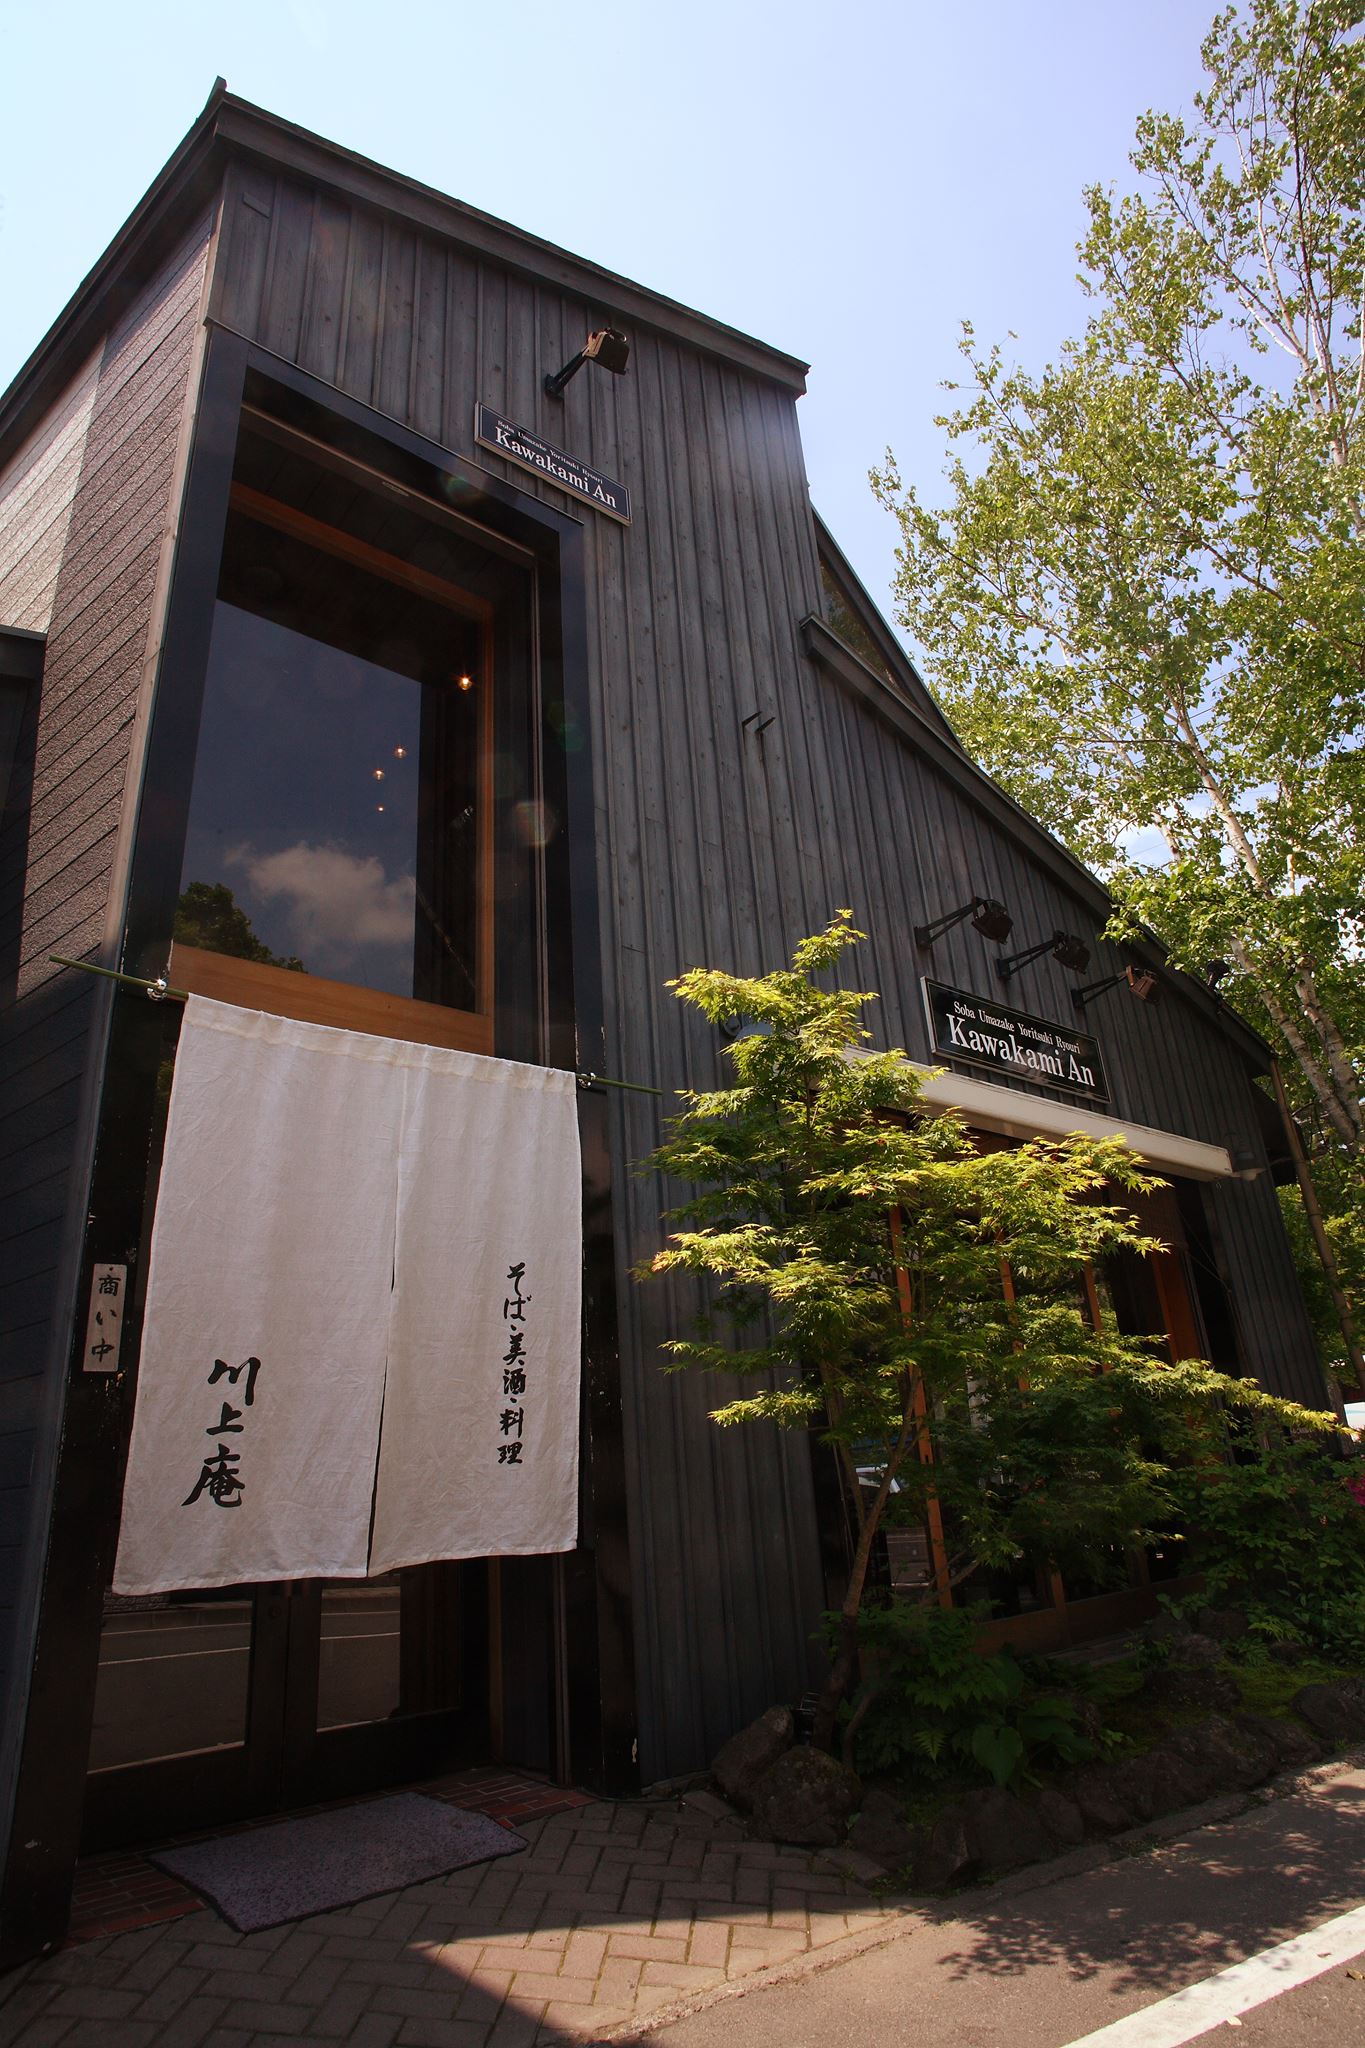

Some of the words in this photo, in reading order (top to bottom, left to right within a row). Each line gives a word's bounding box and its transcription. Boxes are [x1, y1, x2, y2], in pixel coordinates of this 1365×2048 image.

[495, 426, 590, 493] Kawakami
[593, 485, 617, 509] An
[946, 1013, 1065, 1078] Kawakami
[1067, 1054, 1096, 1087] An
[953, 1001, 976, 1019] Soba
[978, 1009, 1015, 1032] Umazake
[1017, 1022, 1054, 1046] Yoritsuki
[1055, 1036, 1081, 1055] Ryouri
[91, 1274, 122, 1363] 商い中
[181, 1356, 261, 1508] 川上庵
